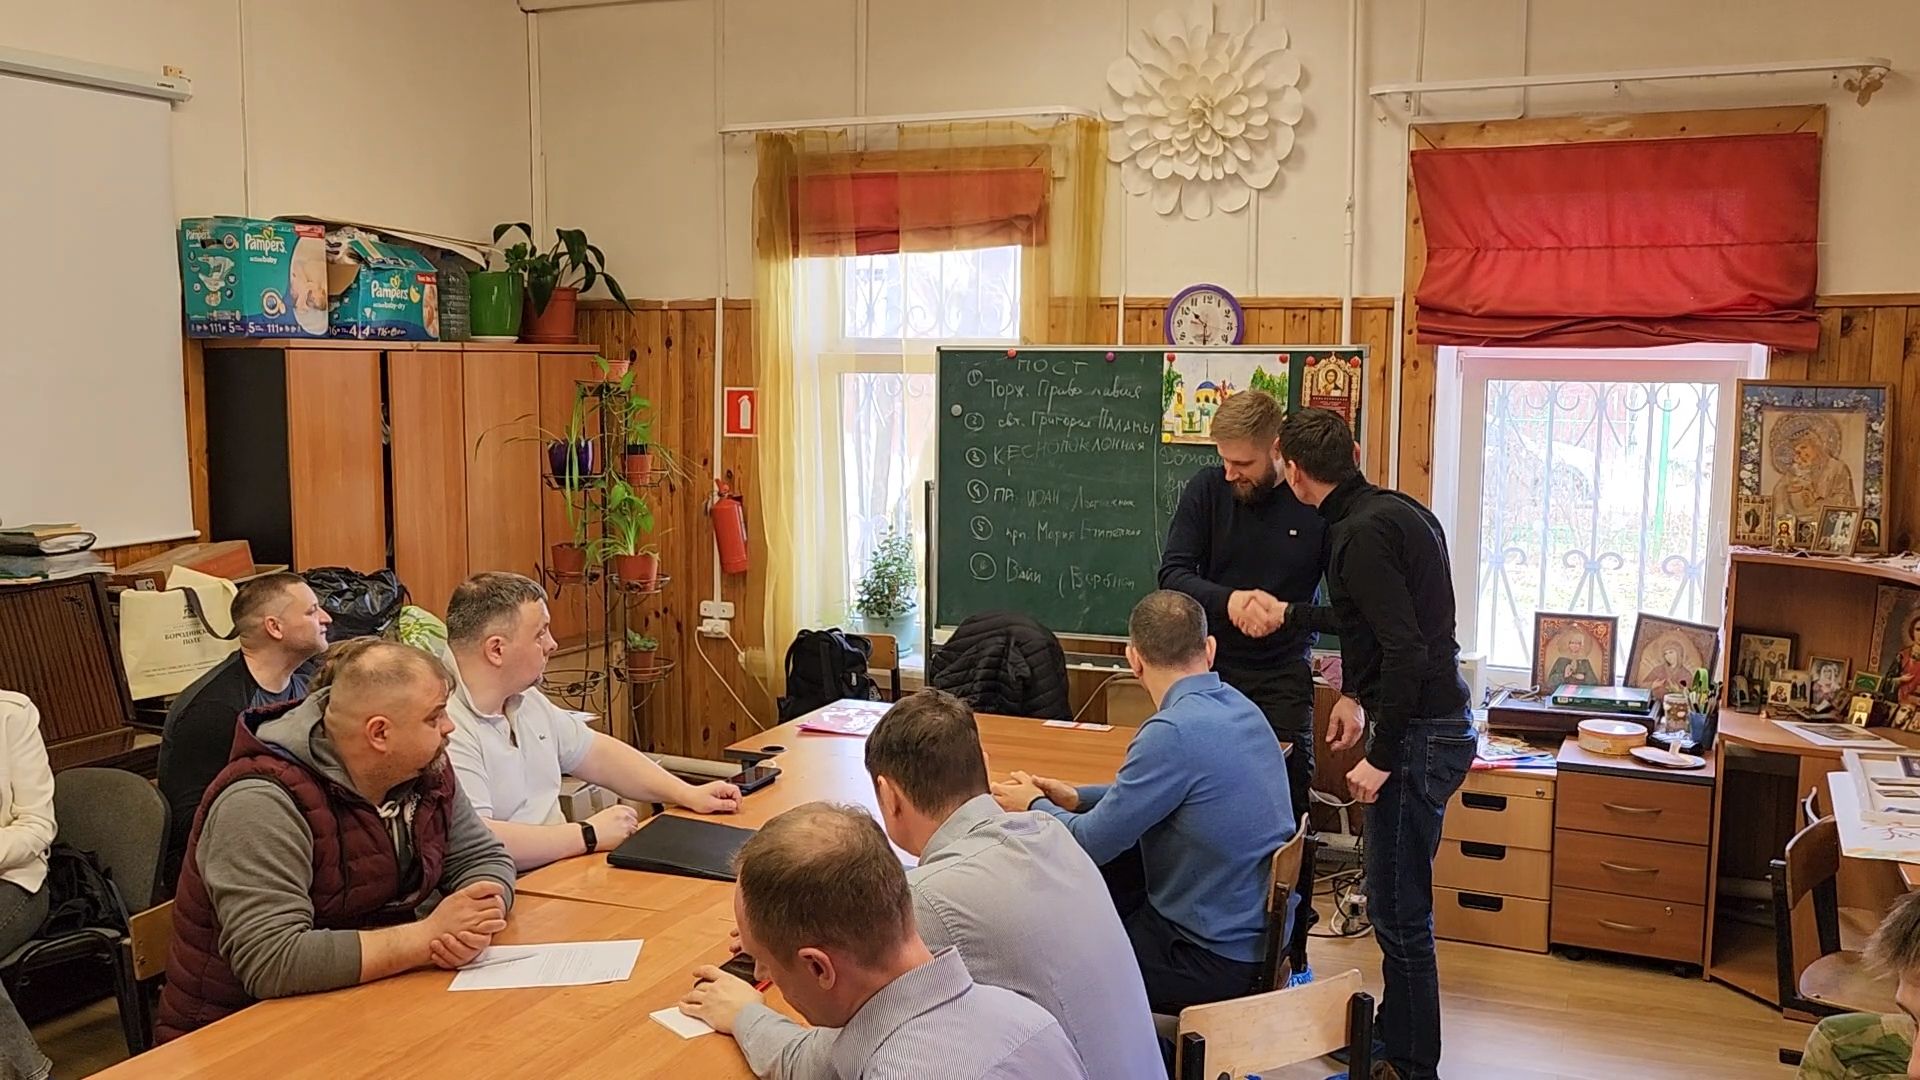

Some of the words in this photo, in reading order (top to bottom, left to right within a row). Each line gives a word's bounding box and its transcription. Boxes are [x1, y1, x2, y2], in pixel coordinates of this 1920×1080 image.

[244, 233, 285, 256] Pampers
[371, 280, 409, 301] Pampers
[1191, 298, 1198, 307] 11
[1203, 295, 1213, 304] 12
[1217, 299, 1221, 308] 1
[1181, 306, 1191, 316] 10
[1224, 308, 1231, 318] 2
[209, 322, 222, 333] 111
[228, 321, 236, 333] 5
[248, 322, 256, 333] 5
[266, 323, 279, 333] 111
[1176, 319, 1184, 328] 9
[1226, 321, 1233, 331] 3
[362, 325, 370, 337] 4
[1179, 331, 1186, 341] 8
[1221, 334, 1229, 344] 4
[1017, 358, 1088, 375] ПОСТ
[984, 378, 1029, 411] Торж.
